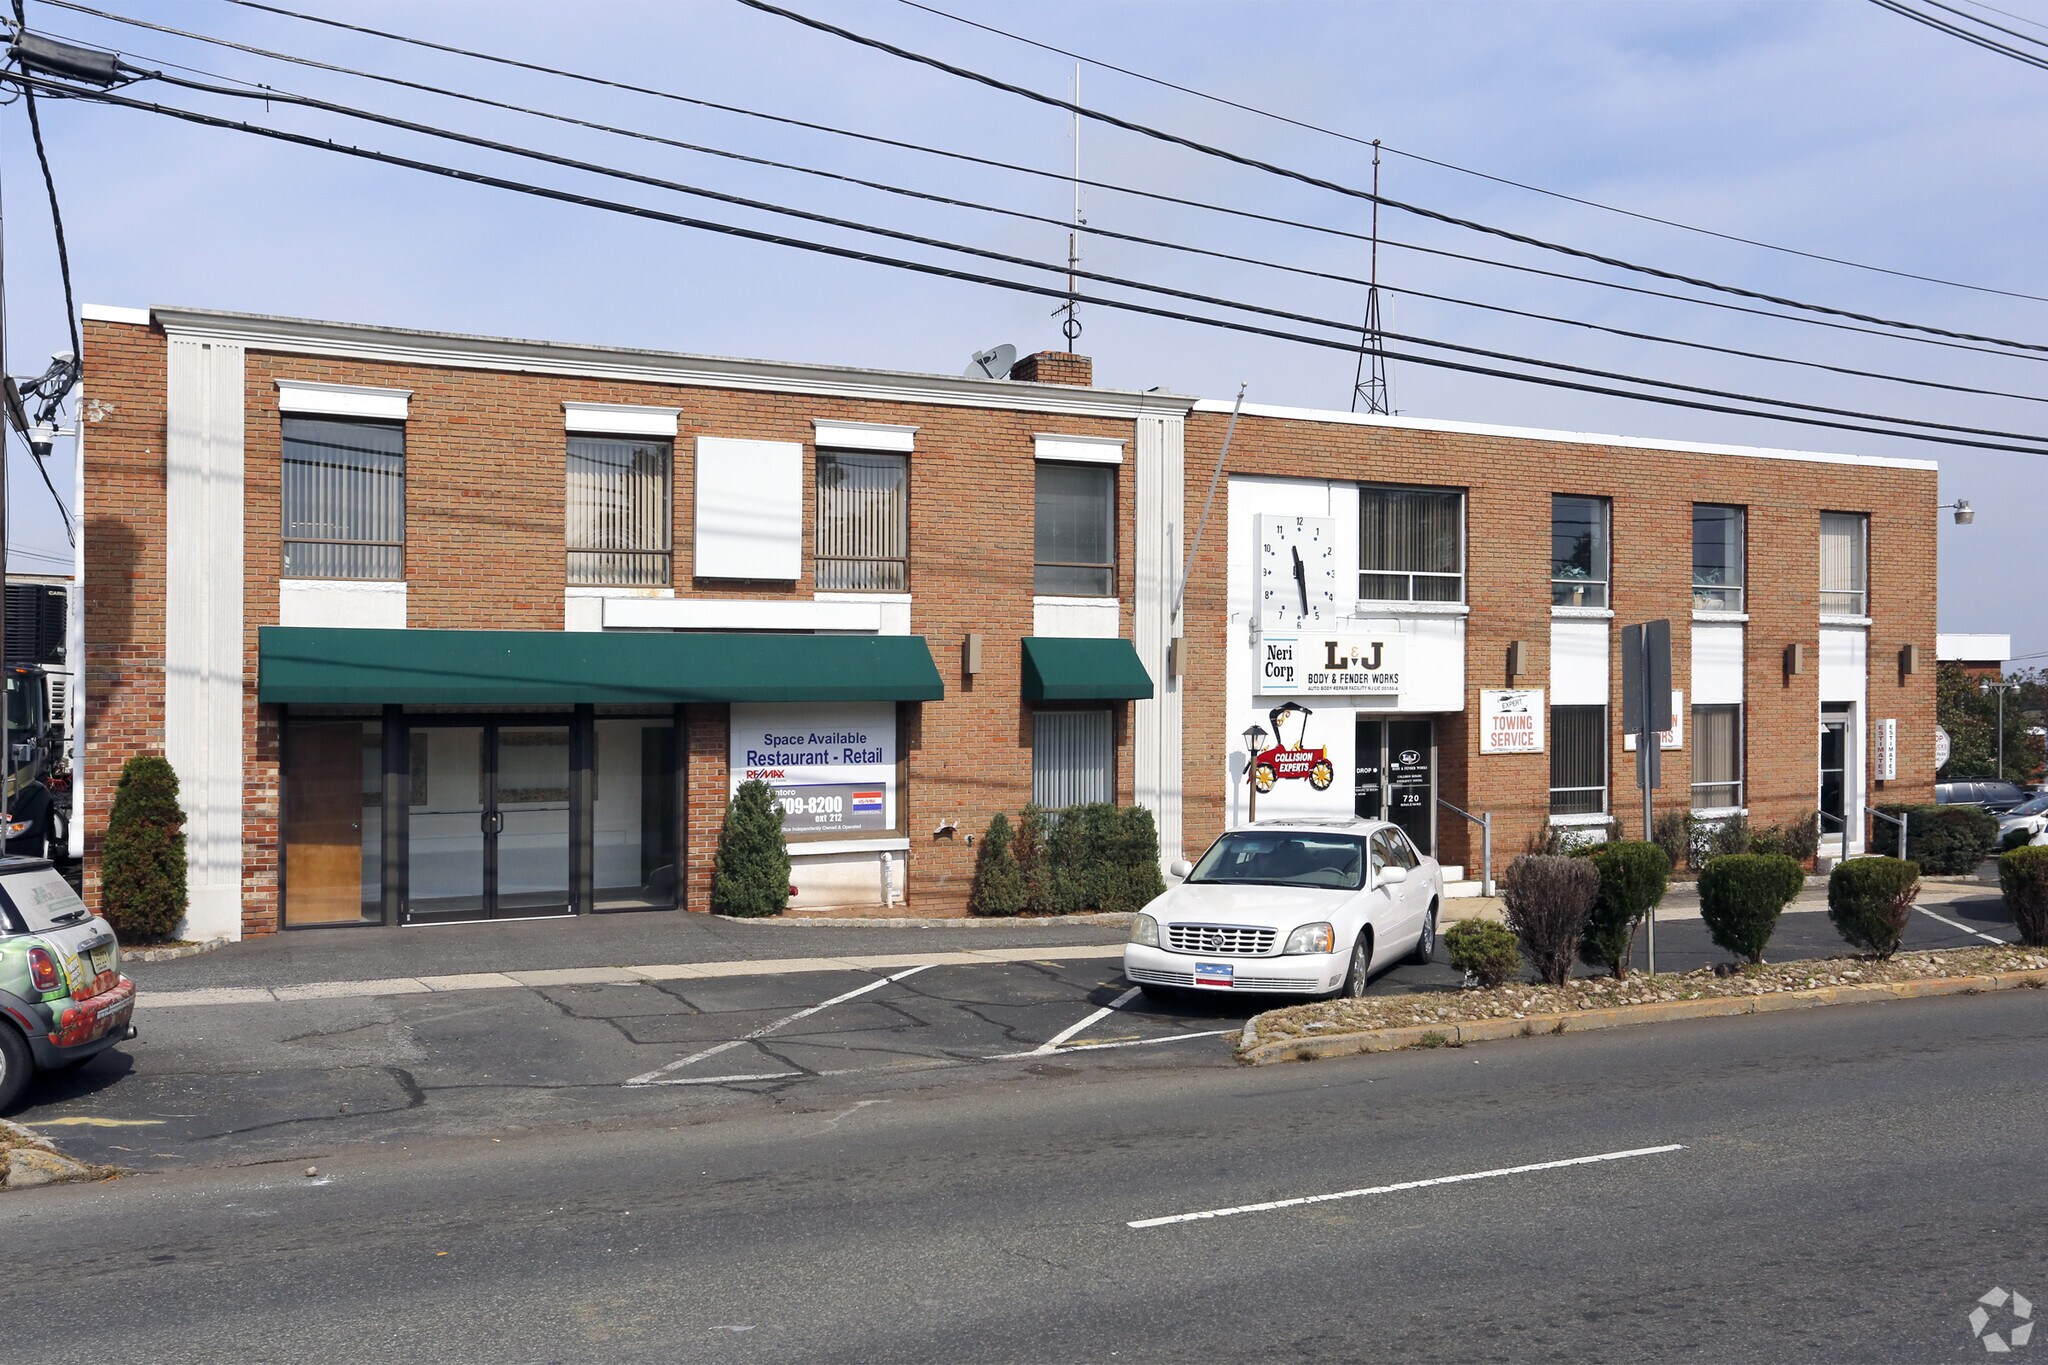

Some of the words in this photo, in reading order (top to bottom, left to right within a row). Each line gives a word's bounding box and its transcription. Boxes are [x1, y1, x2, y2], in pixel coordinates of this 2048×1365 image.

[1296, 516, 1304, 526] 12
[1276, 525, 1282, 534] 11
[1316, 527, 1320, 536] 1
[1264, 544, 1271, 552] 10
[1328, 547, 1332, 556] 2
[1263, 568, 1267, 576] 9
[1331, 570, 1335, 578] 3
[1264, 590, 1270, 600] 8
[1328, 594, 1333, 602] 4
[1278, 611, 1283, 620] 7
[1315, 612, 1320, 620] 5
[1297, 622, 1302, 630] 6
[1267, 645, 1292, 660] Neri
[1265, 662, 1294, 682] Corp.
[1308, 674, 1329, 684] BODY
[1331, 674, 1336, 684] &
[1340, 673, 1368, 684] FENDER
[1372, 673, 1399, 684] WORKS
[1502, 699, 1522, 709] EXPERT
[1493, 715, 1532, 730] TOWING
[764, 733, 804, 748] Space
[808, 732, 867, 744] Available
[1491, 732, 1534, 747] SERVICE
[747, 749, 829, 766] Restaurant
[843, 747, 882, 763] Retail
[1274, 752, 1313, 762] COLLISION
[1279, 763, 1309, 773] EXPERTS
[746, 769, 785, 779] RE/MAX
[815, 814, 827, 823] ext
[829, 813, 842, 822] 212
